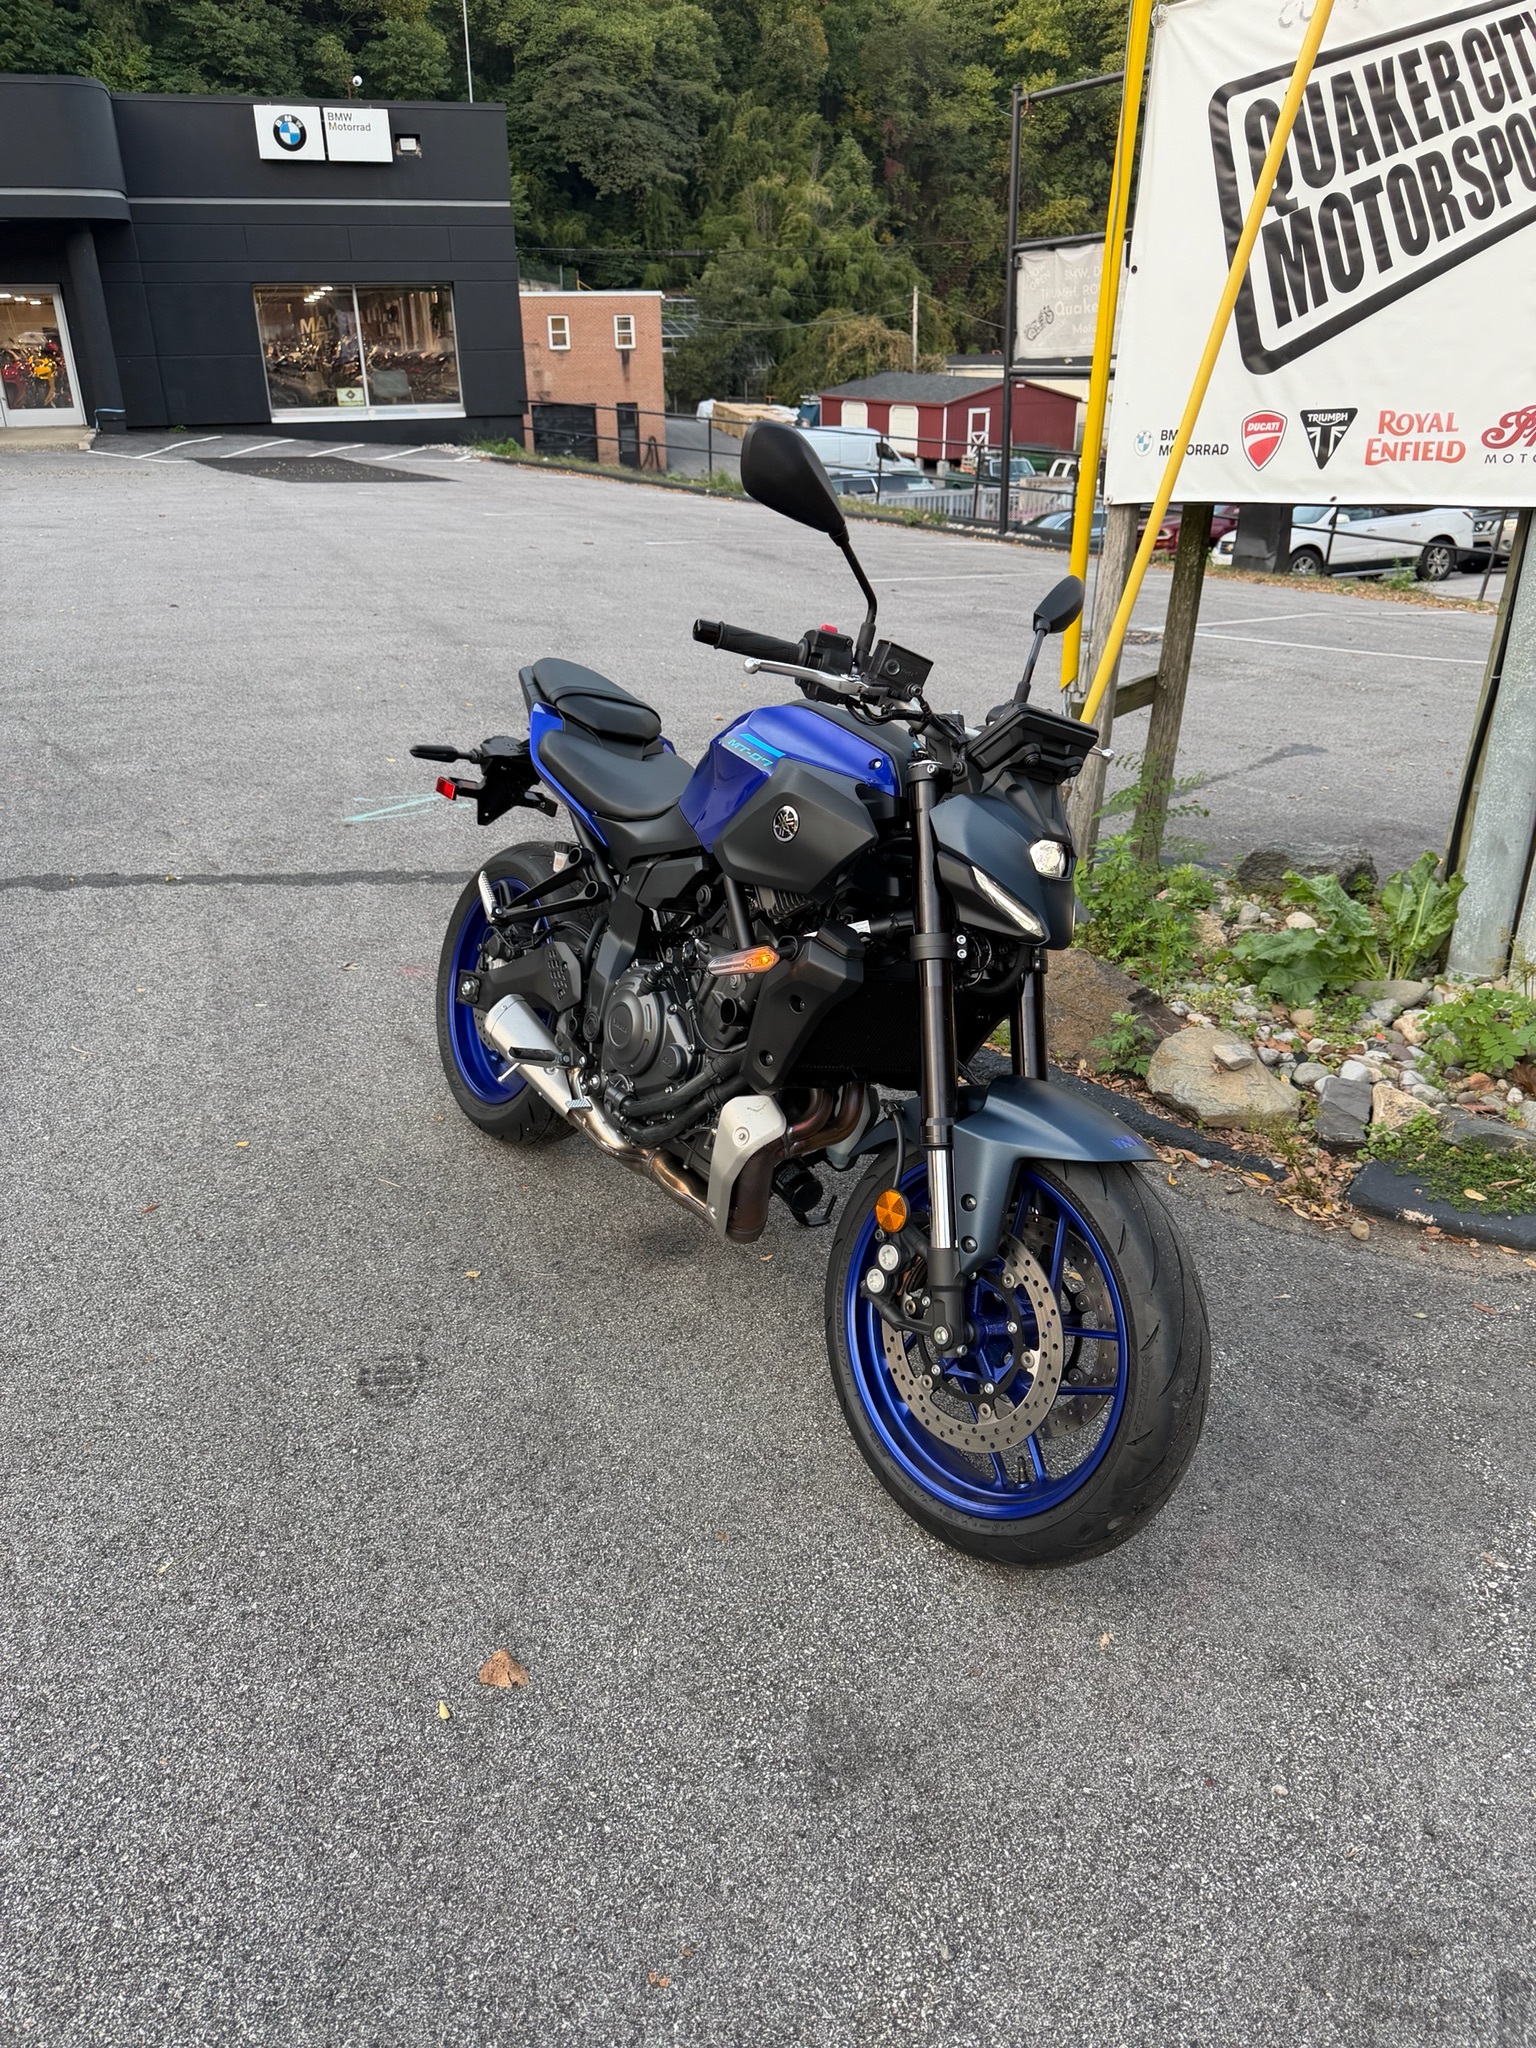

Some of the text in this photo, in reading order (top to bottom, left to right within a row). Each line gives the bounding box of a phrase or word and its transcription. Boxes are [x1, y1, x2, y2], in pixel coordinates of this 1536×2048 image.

[274, 114, 304, 129] BMW
[327, 112, 352, 122] BMW
[328, 122, 371, 132] Motorrad
[1244, 40, 1476, 217] QUAKER
[1261, 106, 1536, 329] MOTORSPO
[1054, 297, 1099, 316] Quake
[1246, 421, 1280, 432] DUCATI
[1307, 412, 1349, 425] TRIUMPH
[1378, 410, 1459, 436] ROYAL
[1160, 429, 1179, 441] BM
[1158, 443, 1230, 456] MORRAD
[1365, 438, 1466, 466] ENFIELD
[727, 738, 774, 767] MT-07
[1134, 1366, 1151, 1434] DUNLOP
